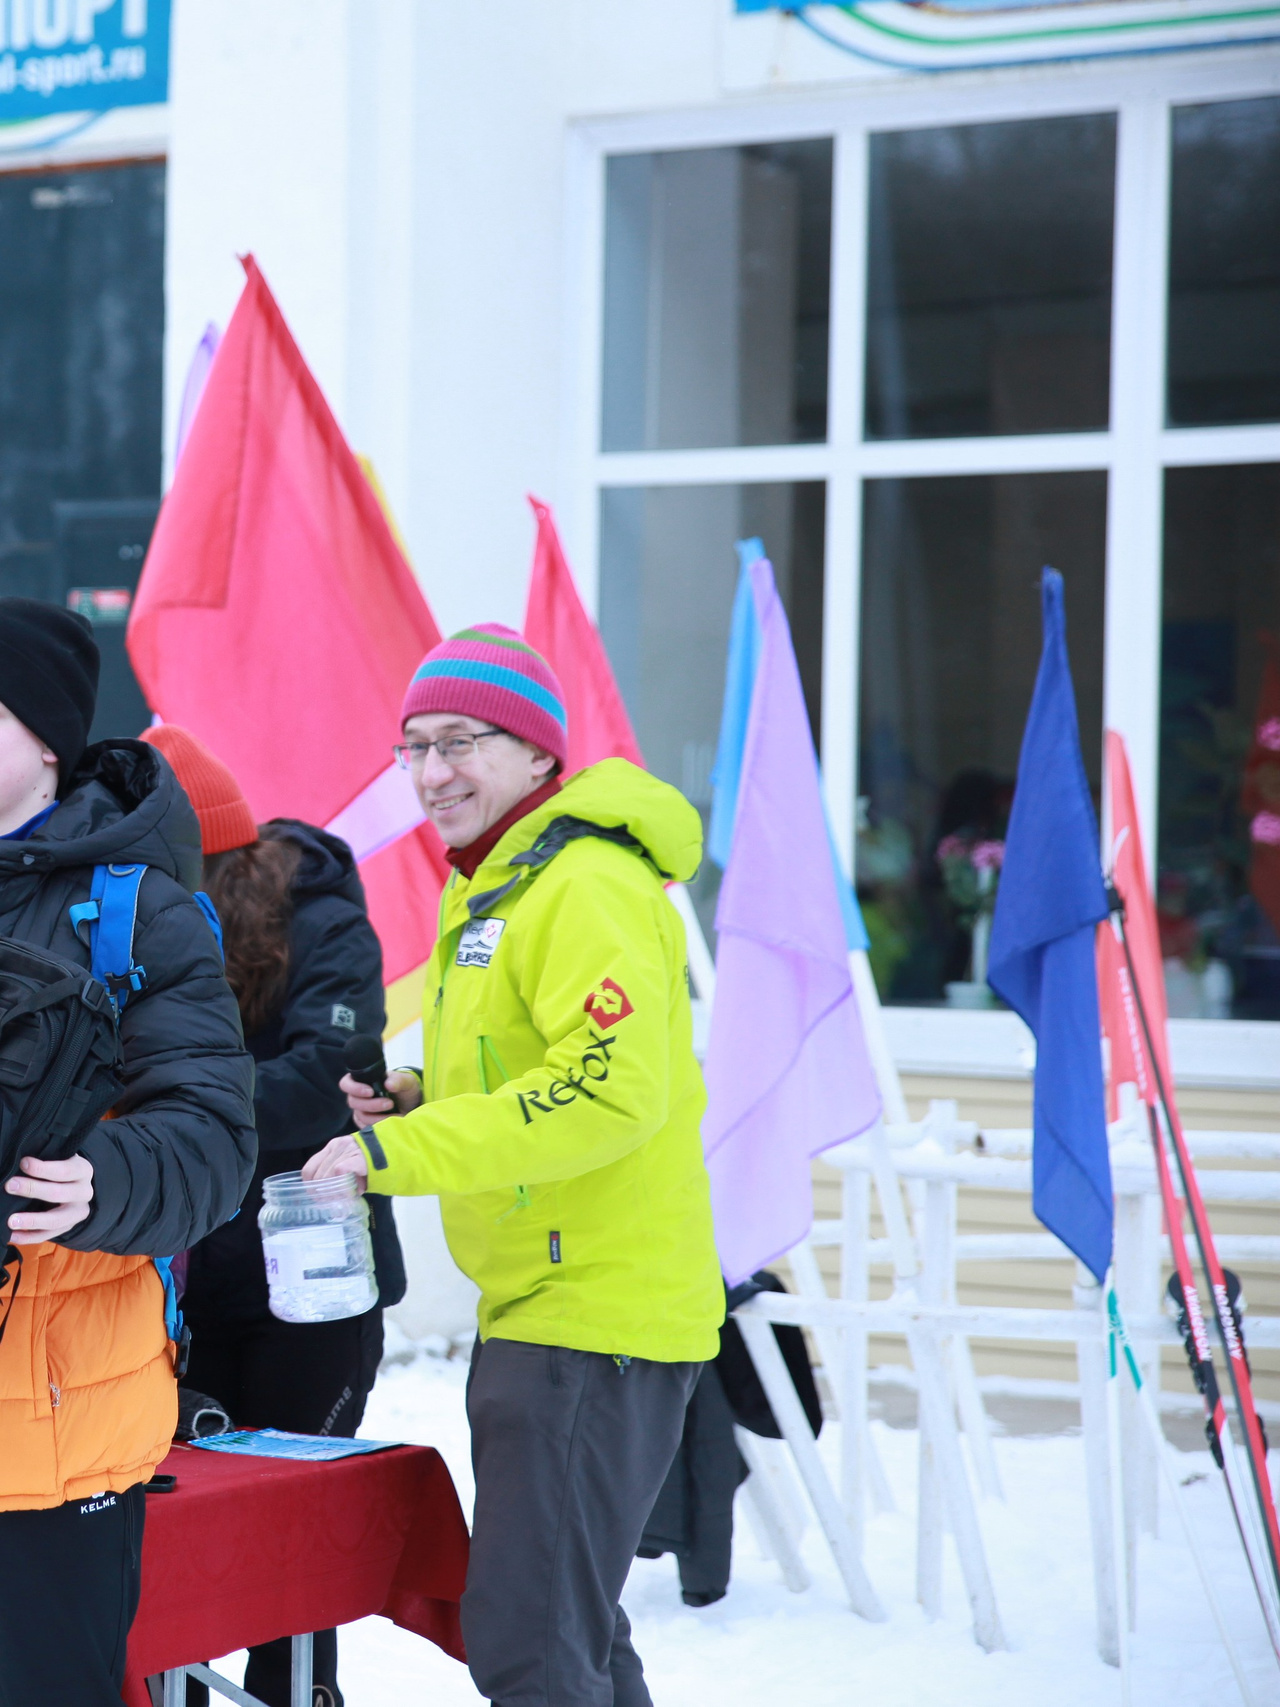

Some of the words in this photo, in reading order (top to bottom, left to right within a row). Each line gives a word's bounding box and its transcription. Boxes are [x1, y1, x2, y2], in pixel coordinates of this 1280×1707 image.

[516, 1028, 617, 1125] Refox
[1183, 1285, 1213, 1361] NORDWAY
[1212, 1284, 1243, 1361] NORDWAY
[80, 1495, 117, 1515] KELME
